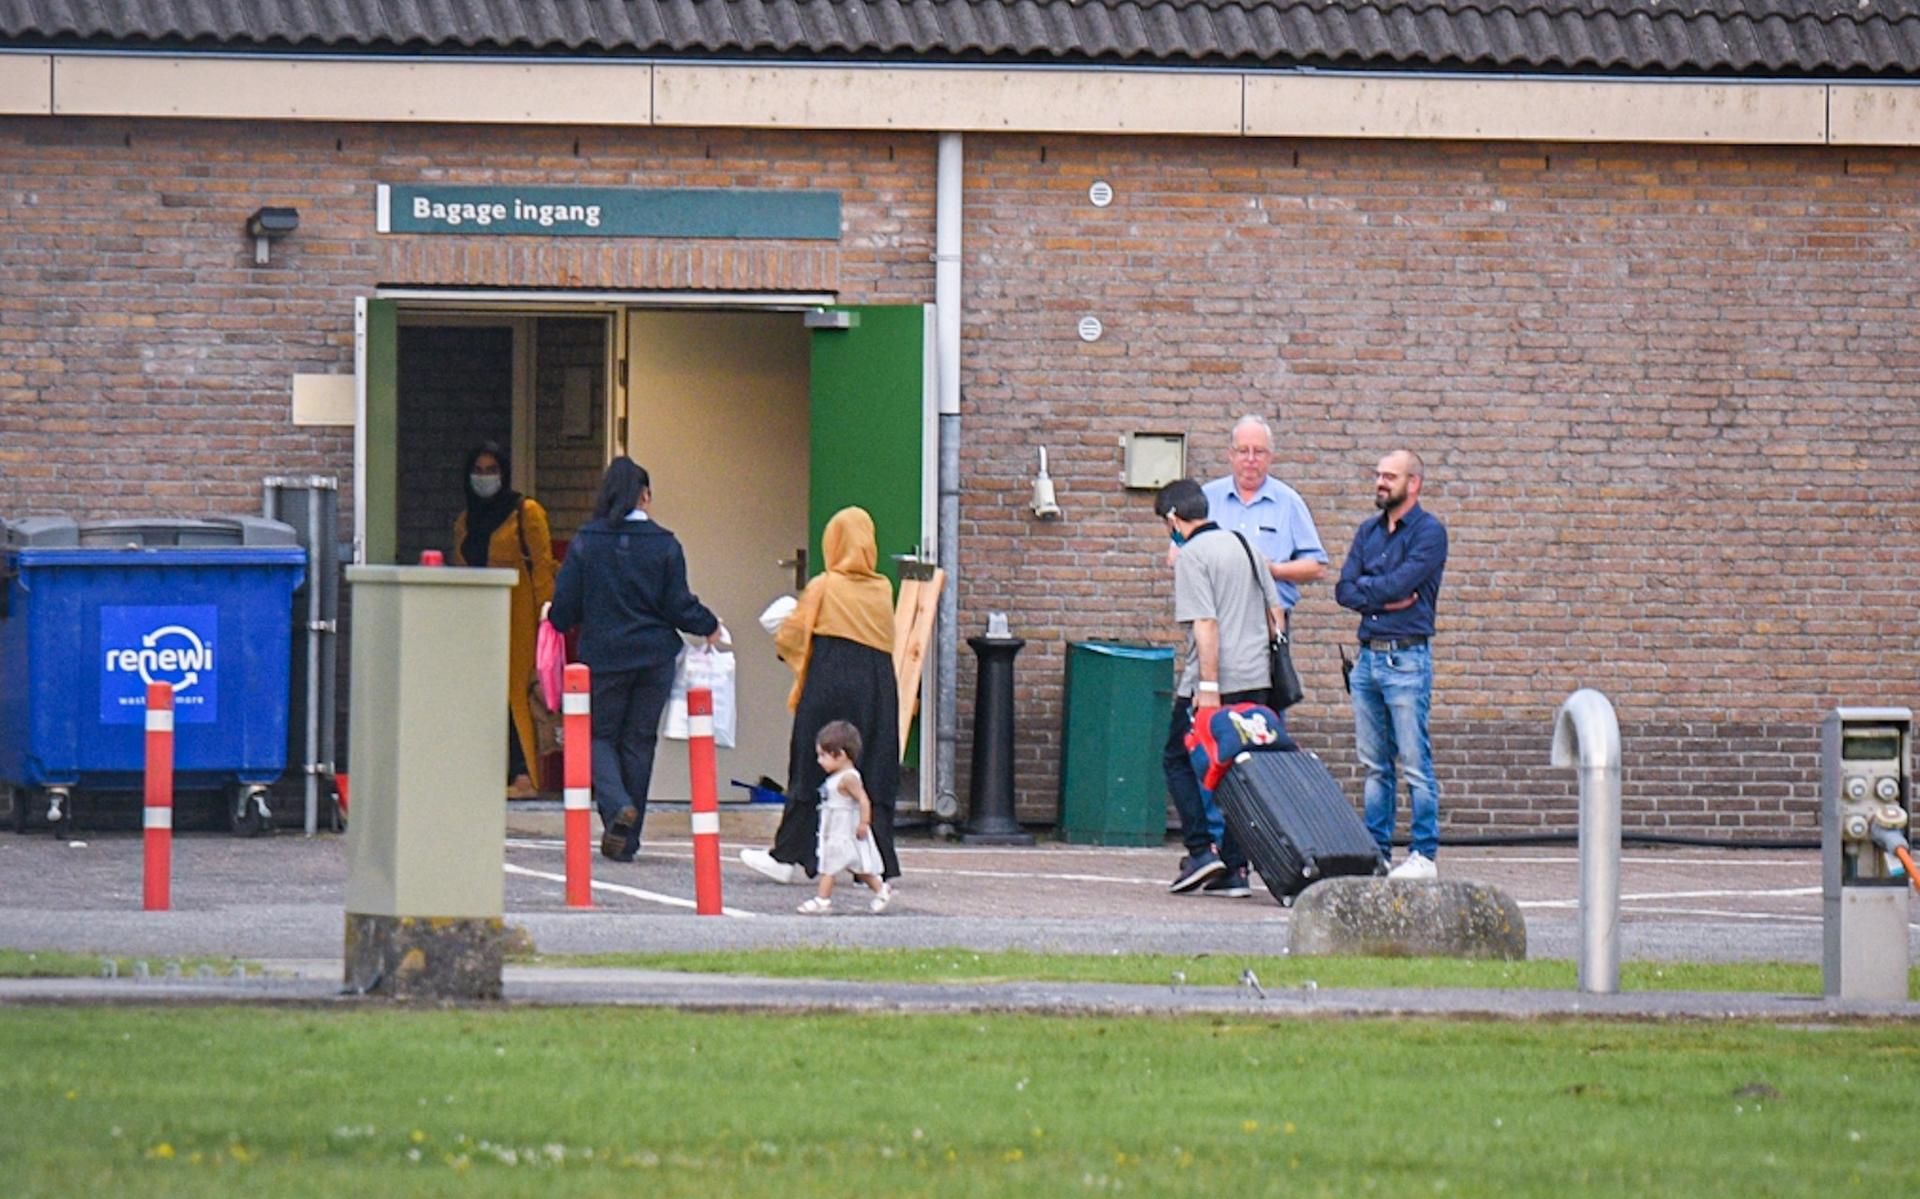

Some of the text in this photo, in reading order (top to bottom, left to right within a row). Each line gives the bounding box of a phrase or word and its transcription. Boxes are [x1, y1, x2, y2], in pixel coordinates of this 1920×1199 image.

[413, 197, 601, 227] Bagage ingang
[106, 643, 213, 672] renewi
[118, 696, 204, 705] wast more
